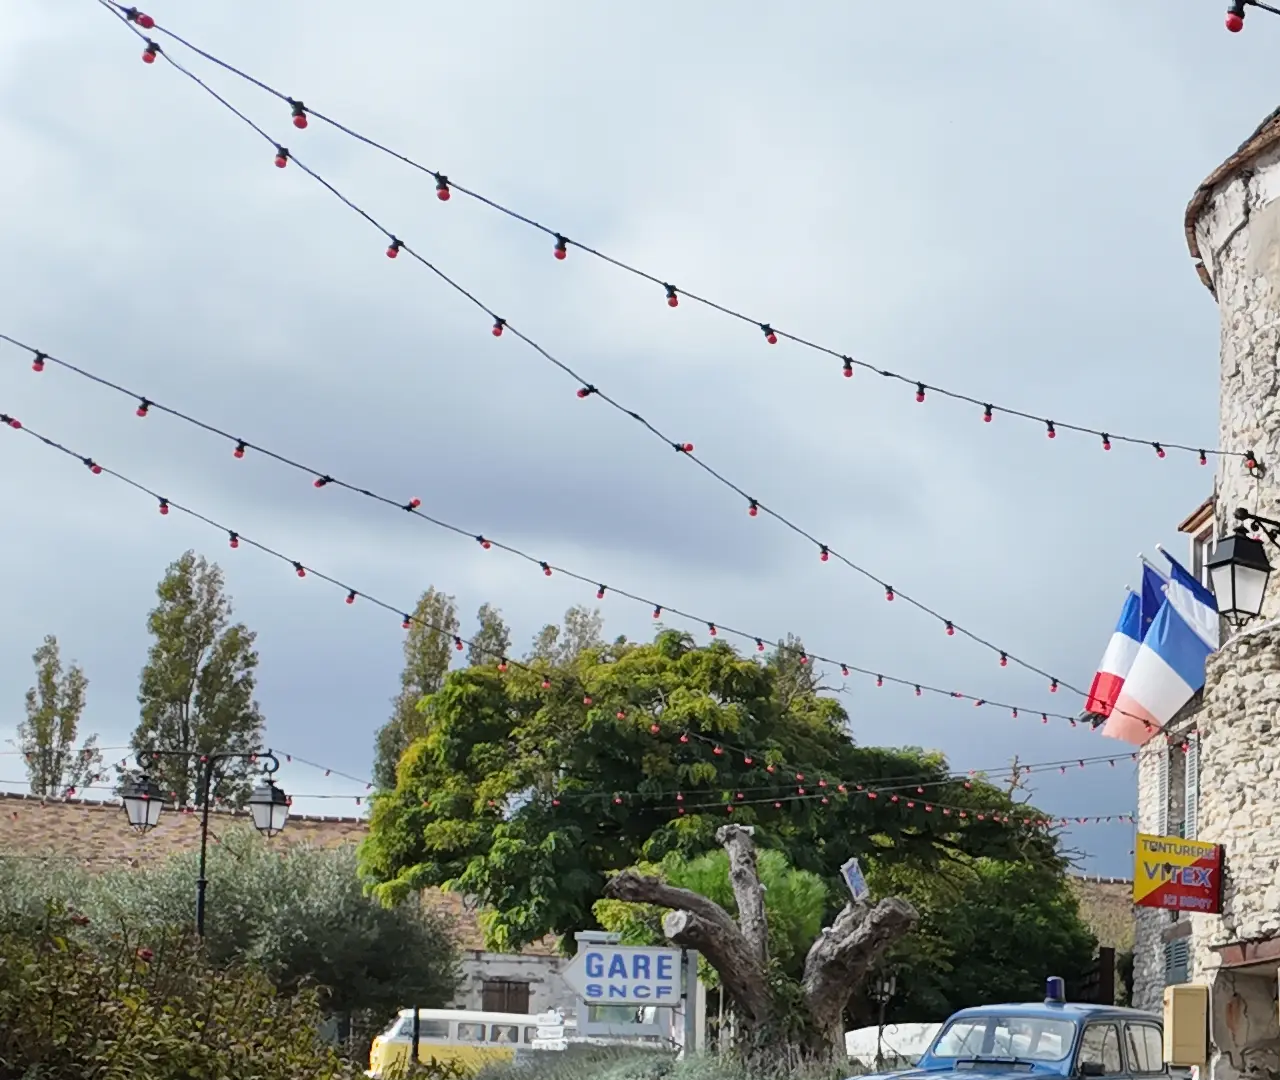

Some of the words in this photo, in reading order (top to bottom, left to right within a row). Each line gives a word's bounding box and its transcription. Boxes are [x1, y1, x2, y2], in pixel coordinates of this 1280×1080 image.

[1144, 861, 1213, 888] VITEX
[586, 952, 672, 980] GARE
[586, 984, 672, 998] SNCF
